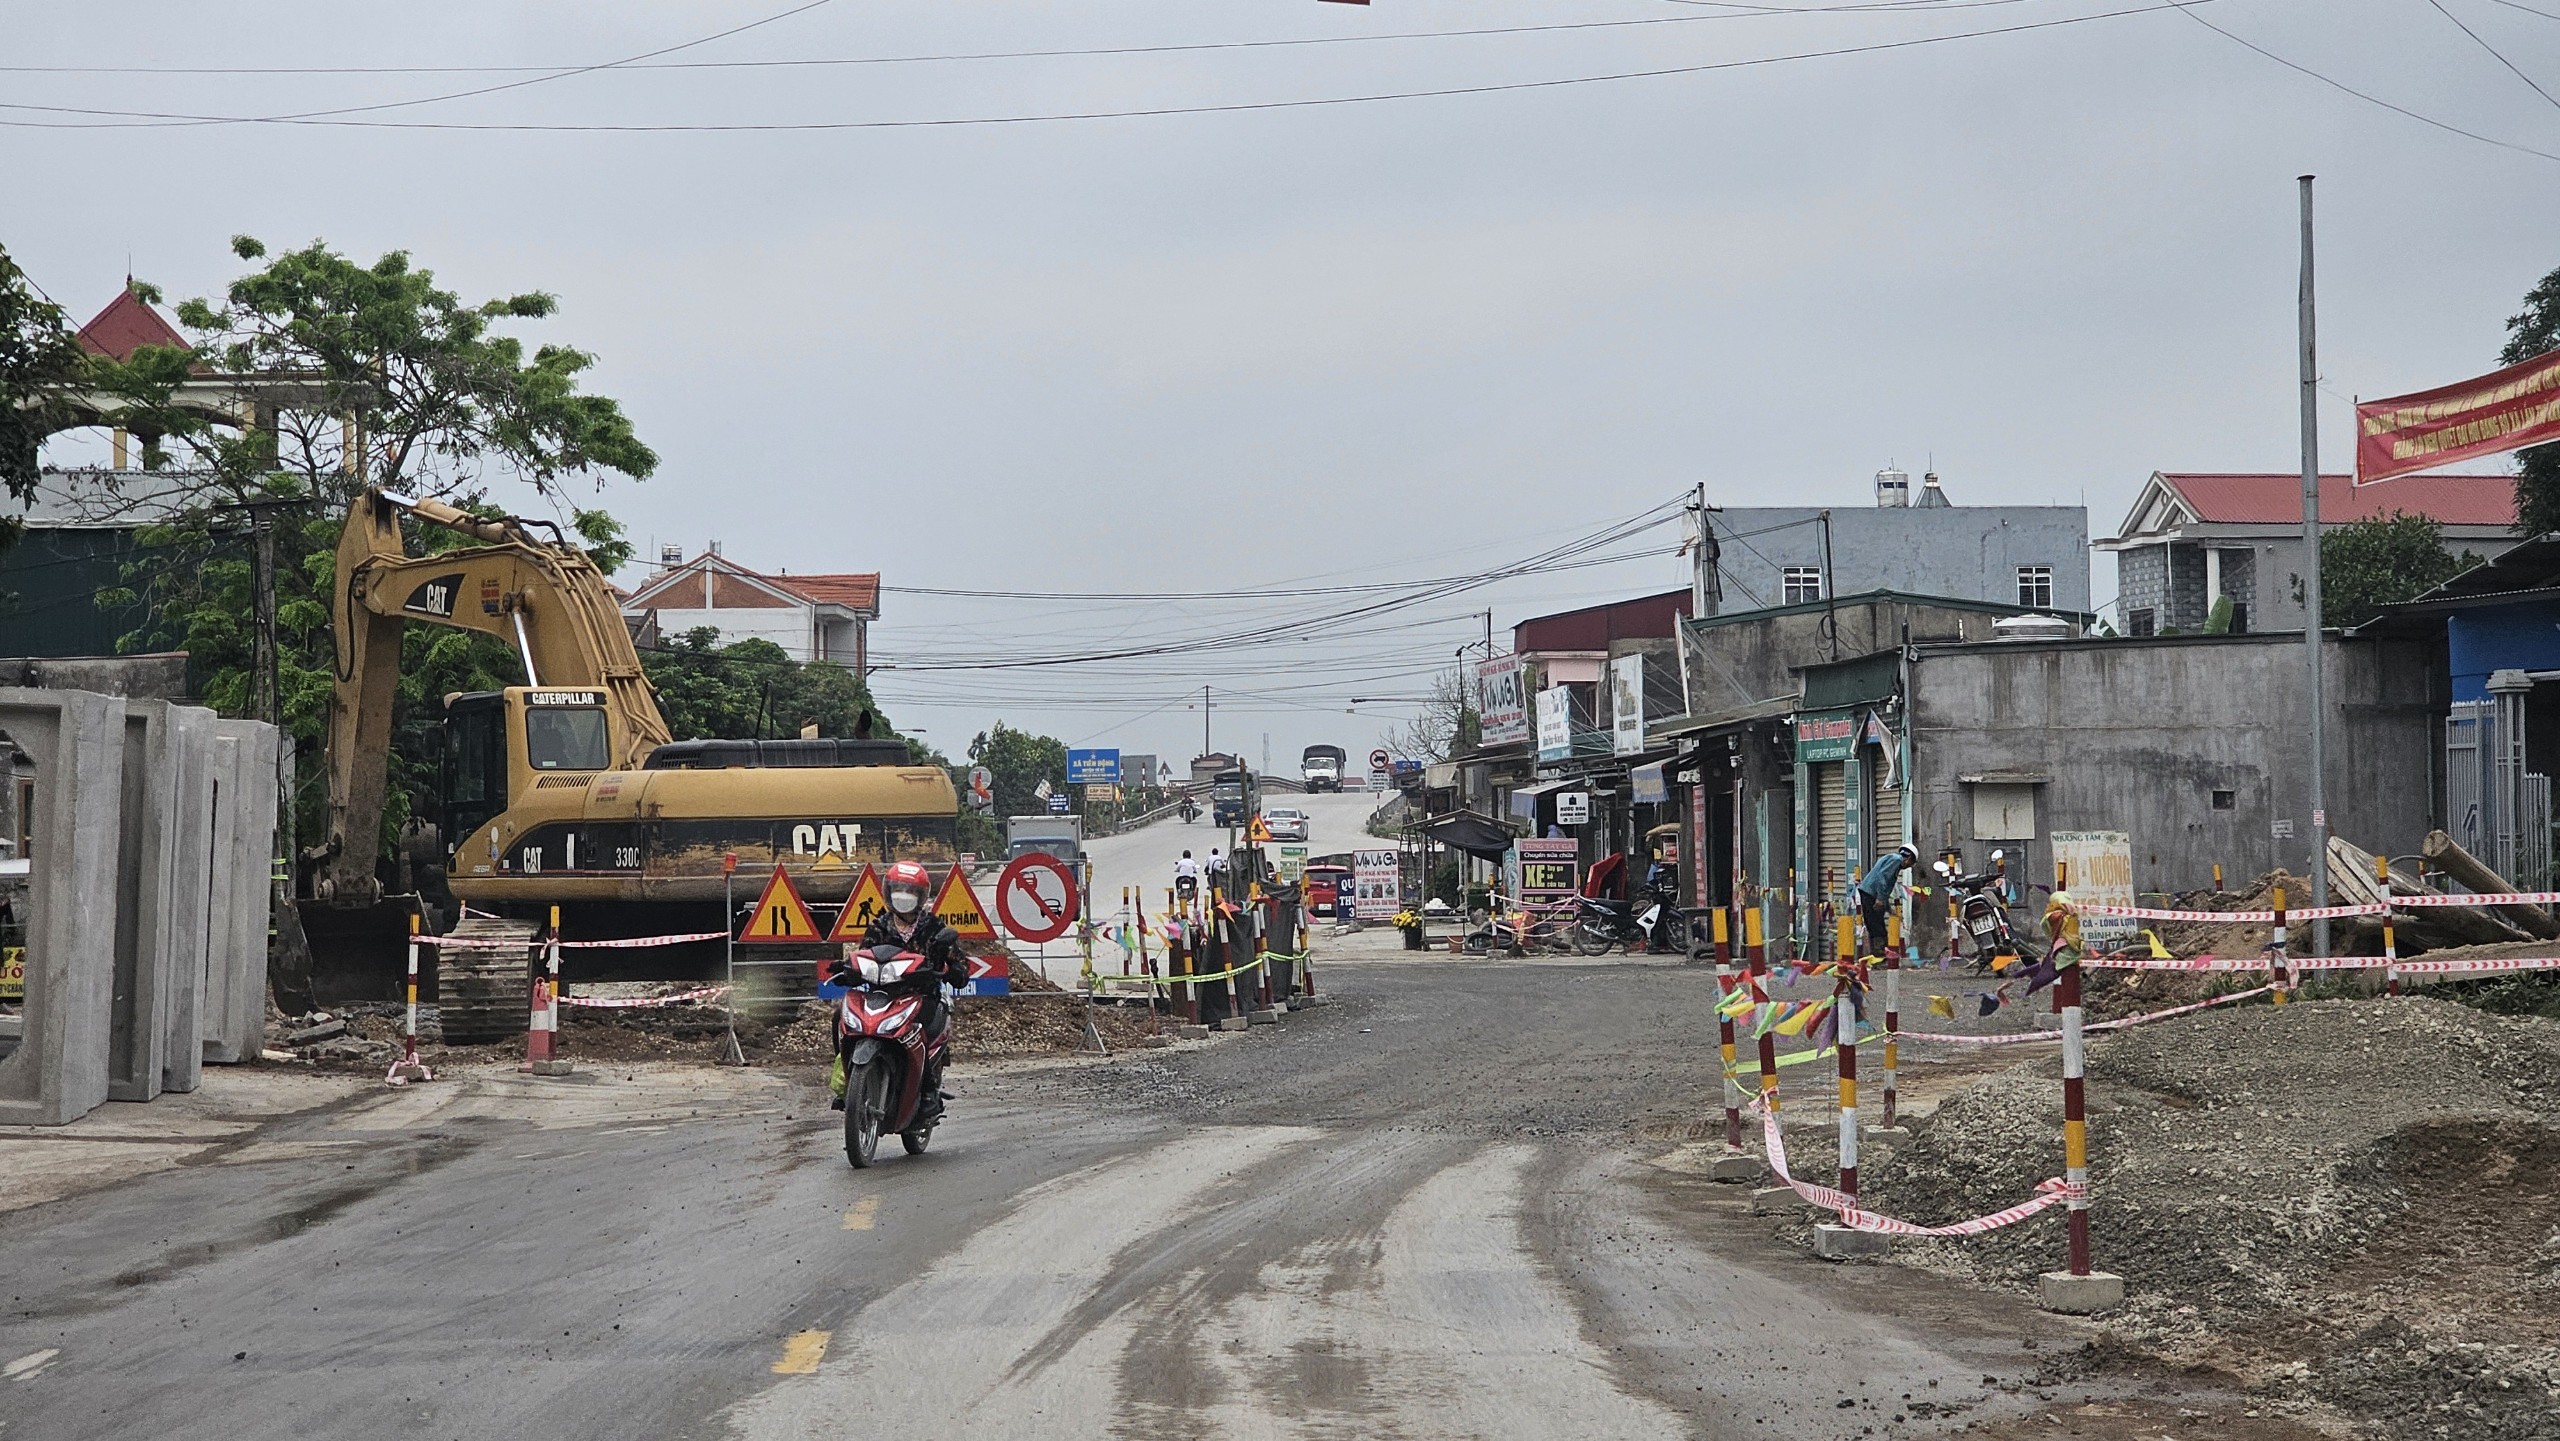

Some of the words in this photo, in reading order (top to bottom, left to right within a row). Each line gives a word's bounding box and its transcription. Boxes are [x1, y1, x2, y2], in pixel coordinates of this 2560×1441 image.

[427, 584, 447, 614] CAT
[532, 692, 595, 705] CATERPILLAR
[793, 824, 861, 862] CAT
[524, 847, 543, 873] CAT
[616, 847, 640, 867] 330C
[1525, 865, 1545, 888] XE
[950, 910, 979, 928] CHẬM
